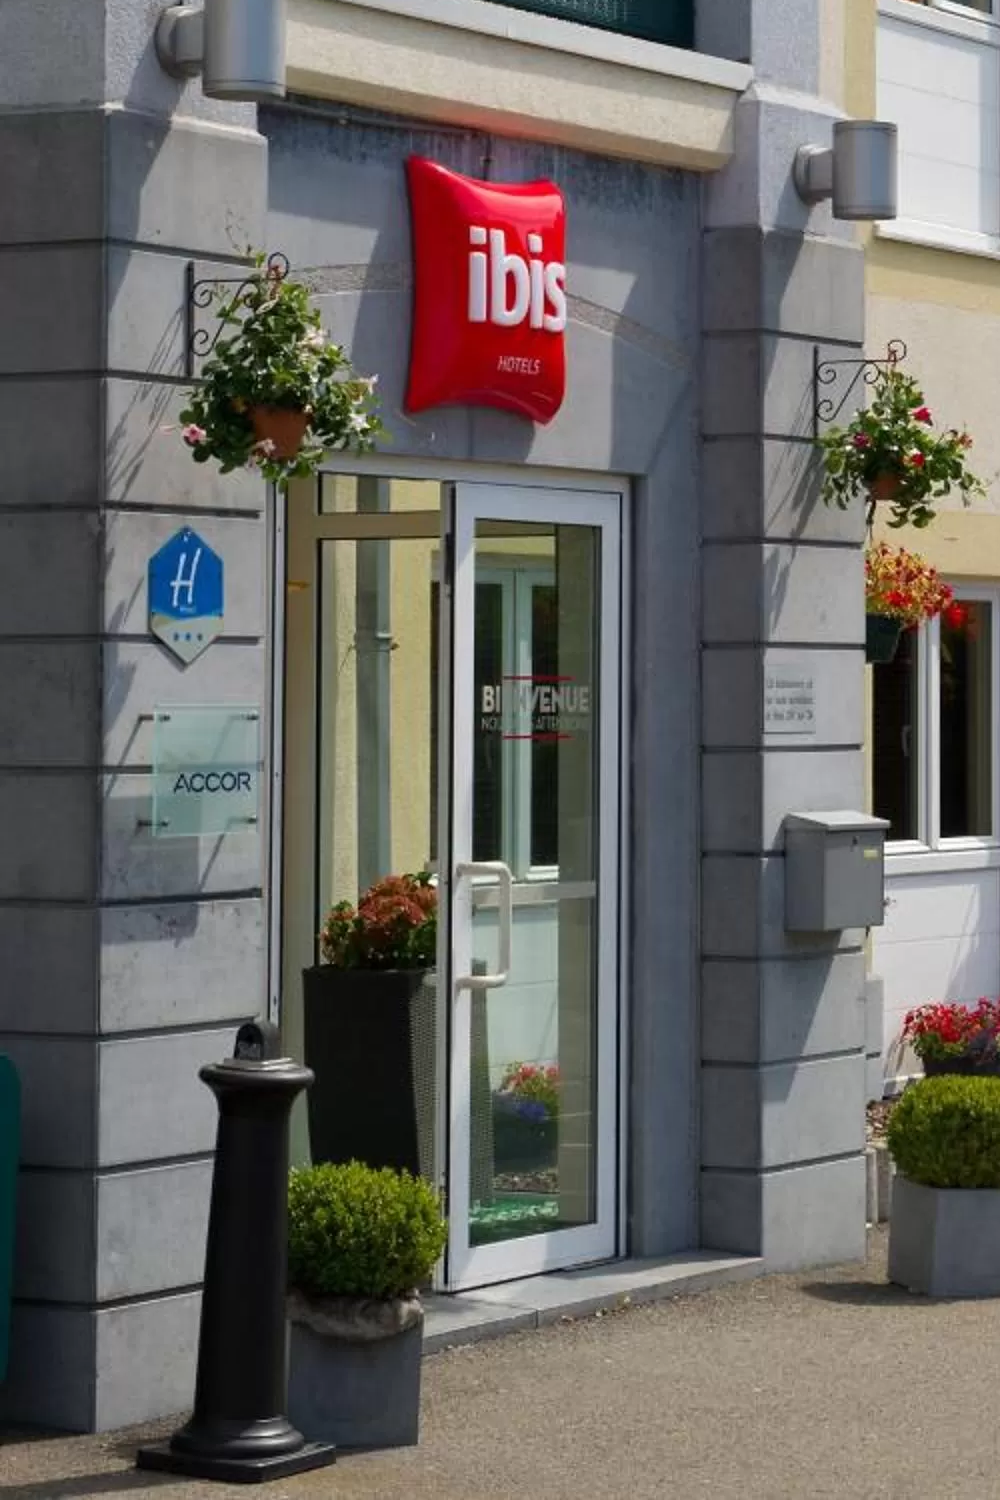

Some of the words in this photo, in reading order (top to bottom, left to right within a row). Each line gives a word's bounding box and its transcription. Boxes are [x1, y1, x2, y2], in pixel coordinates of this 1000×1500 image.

[468, 225, 567, 332] ibis
[497, 355, 540, 375] HOTELS
[173, 771, 251, 793] ACCOR
